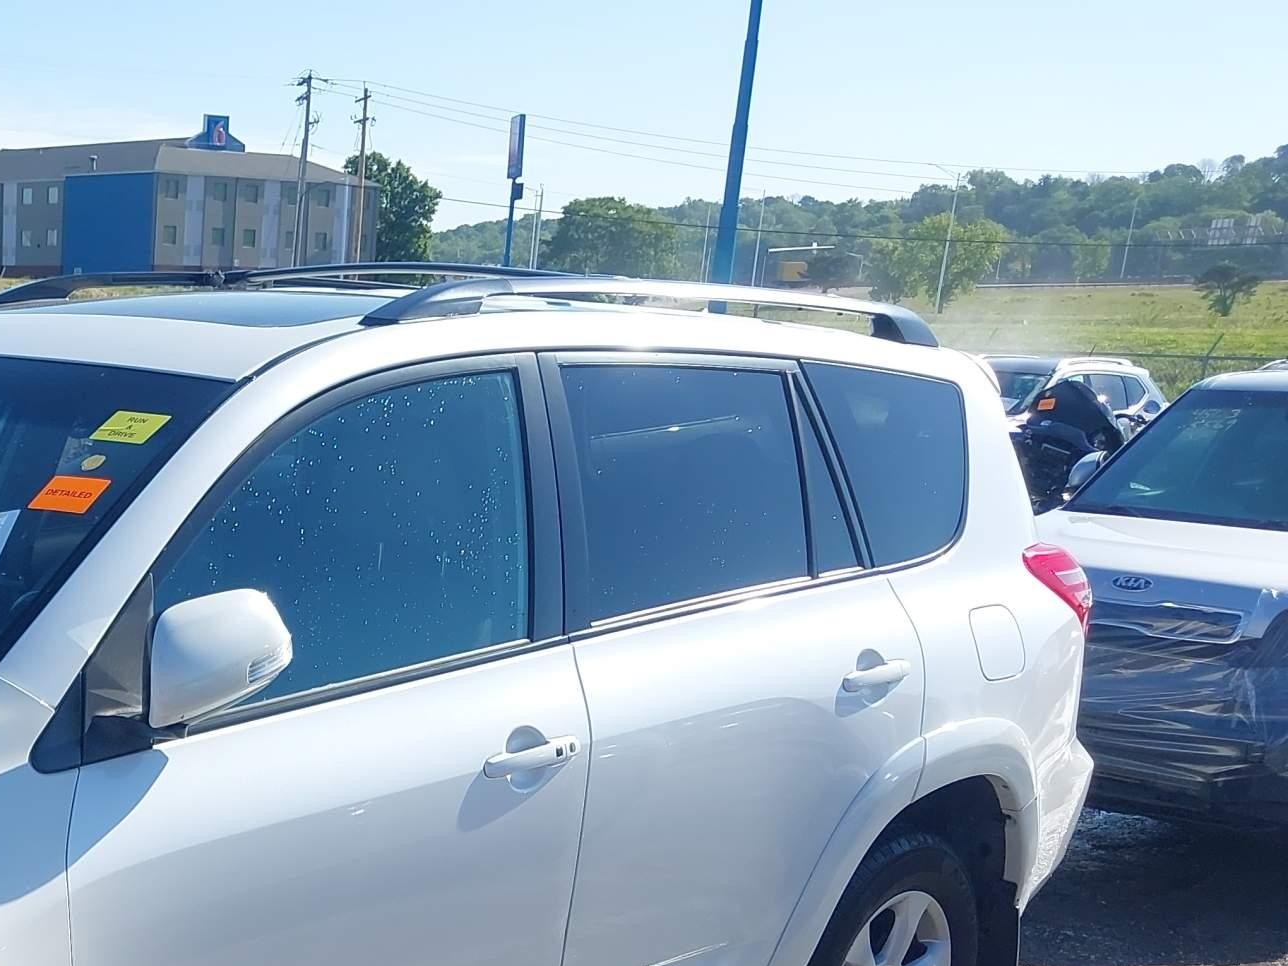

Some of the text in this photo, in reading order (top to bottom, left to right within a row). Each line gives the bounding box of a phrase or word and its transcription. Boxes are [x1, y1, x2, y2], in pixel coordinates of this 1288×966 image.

[126, 416, 150, 424] RUN
[107, 430, 137, 439] DRIVE
[45, 488, 93, 499] DETAILED
